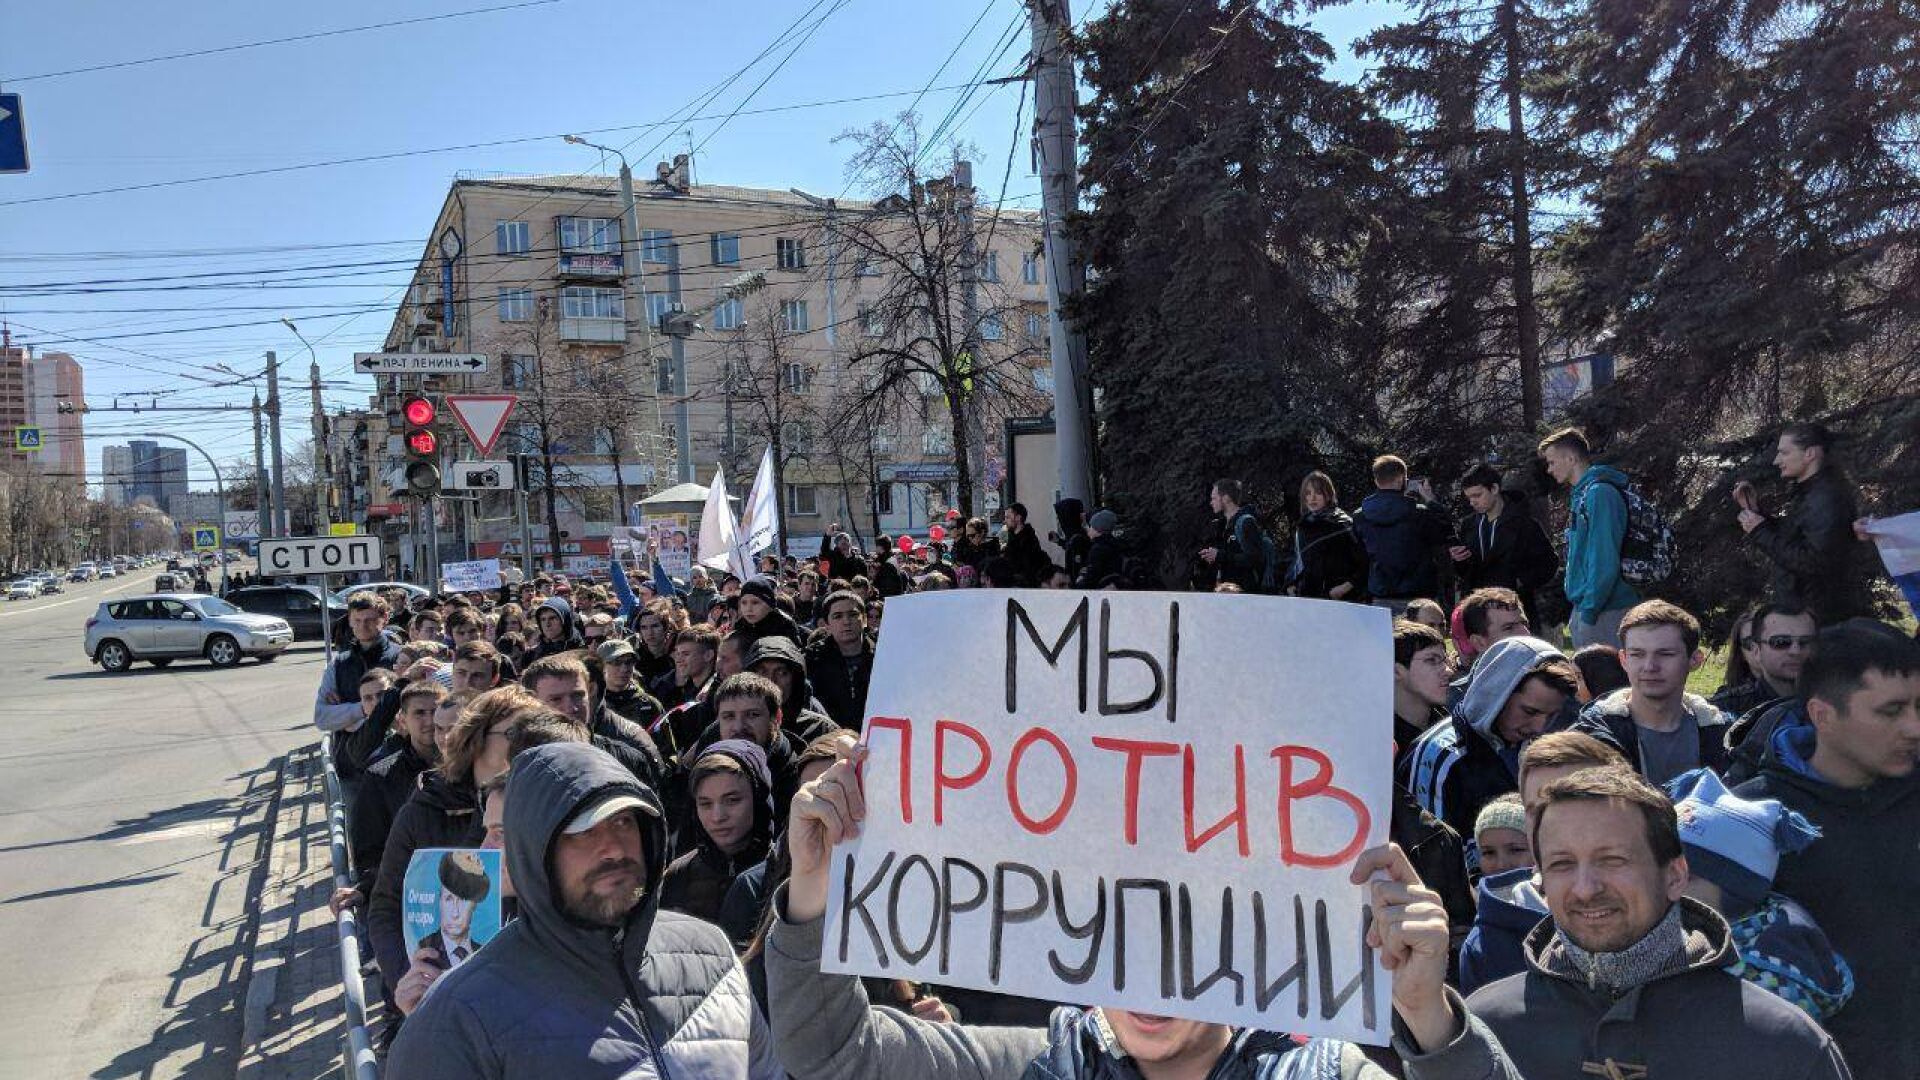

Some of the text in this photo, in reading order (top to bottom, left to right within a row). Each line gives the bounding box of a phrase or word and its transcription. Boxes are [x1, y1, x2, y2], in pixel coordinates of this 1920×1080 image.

[383, 357, 460, 368] ПР-Т ЛЕНИНА
[272, 543, 369, 569] СТОП
[1006, 596, 1180, 723] МЫ
[857, 717, 1372, 869] ПРОТИВ
[839, 851, 1377, 1032] КОРРУПЦИИ
